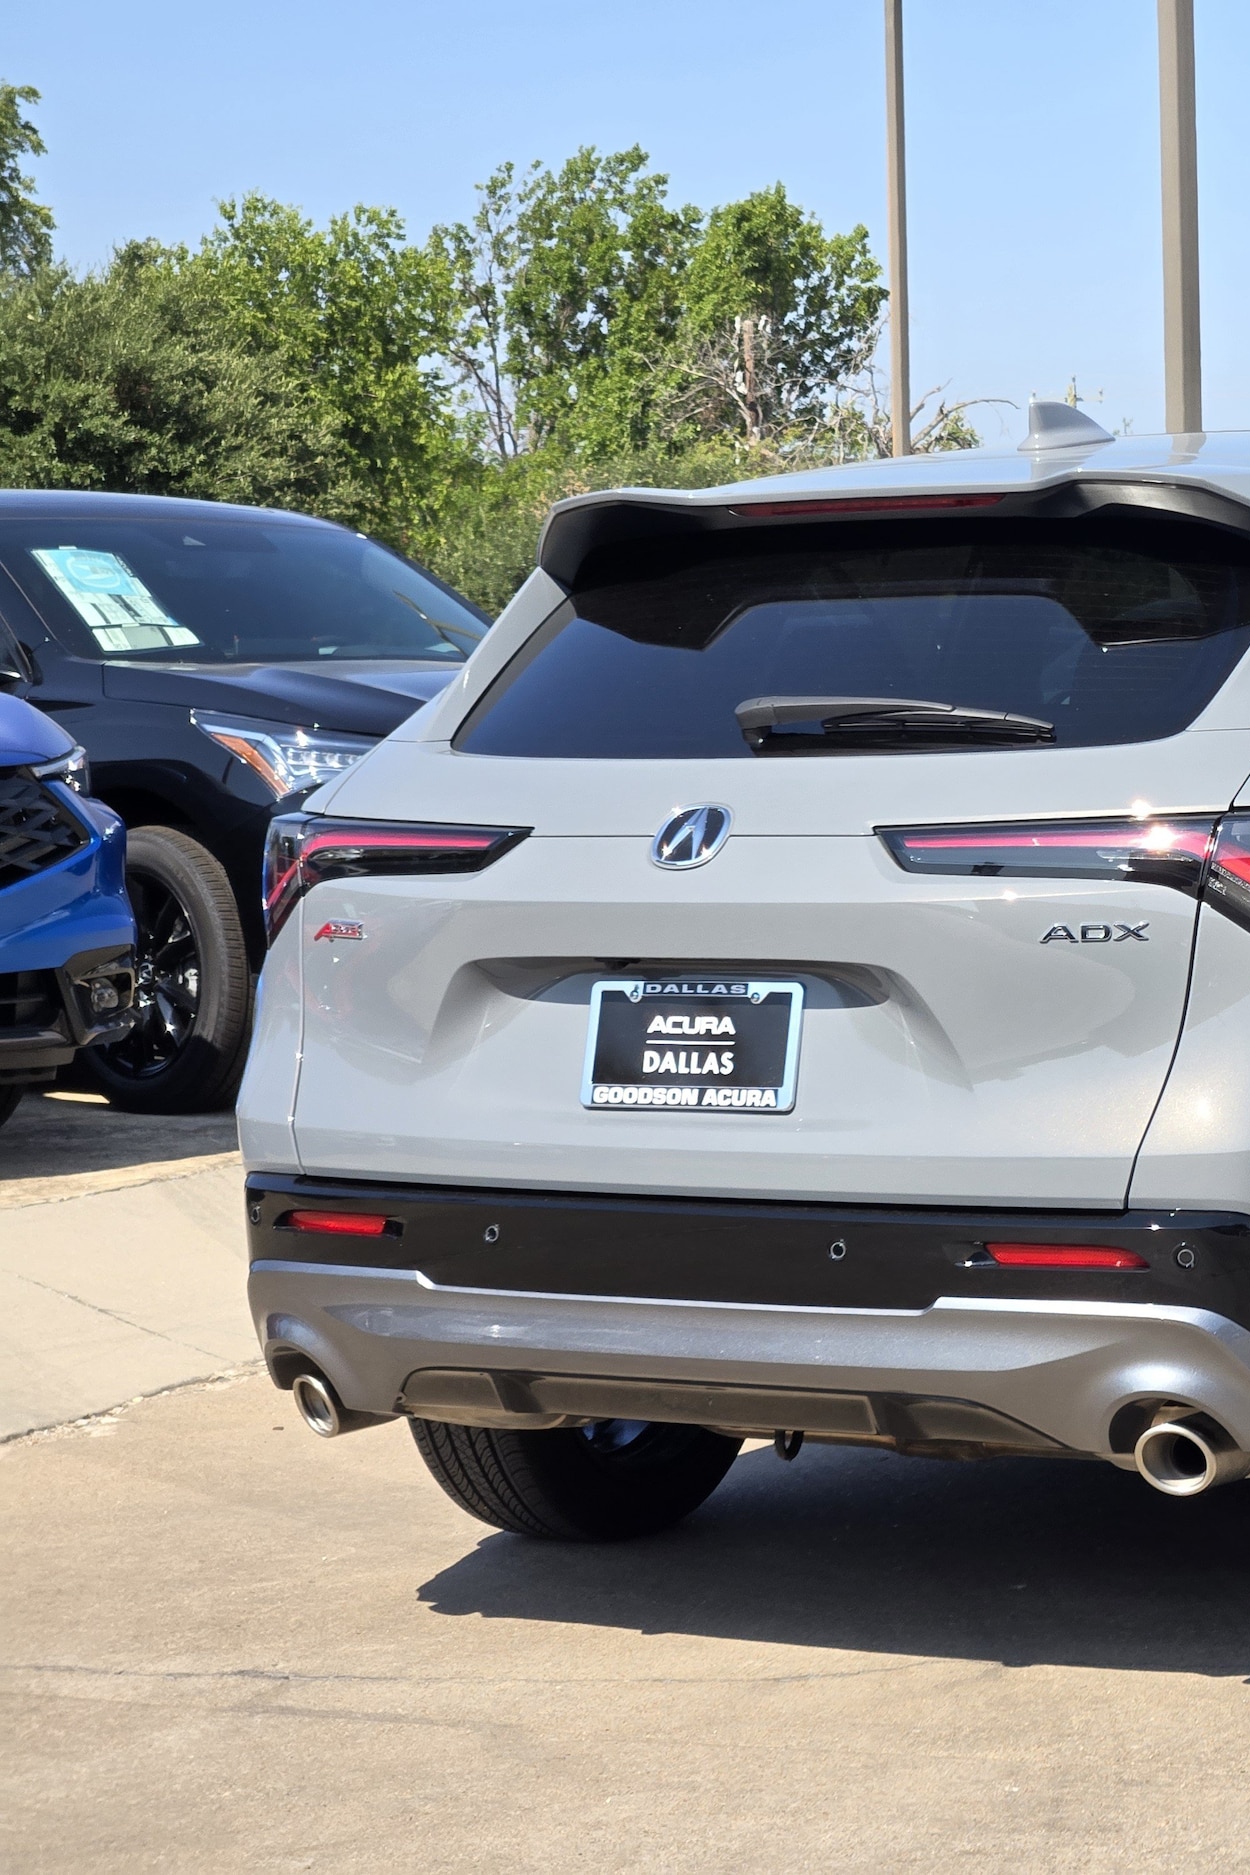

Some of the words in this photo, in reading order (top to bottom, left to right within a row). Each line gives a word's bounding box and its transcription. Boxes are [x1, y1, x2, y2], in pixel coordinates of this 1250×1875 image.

[1039, 921, 1150, 944] ADX
[646, 983, 747, 995] DALLAS
[647, 1015, 736, 1035] ACURA
[642, 1050, 735, 1076] DALLAS
[593, 1086, 698, 1107] GOODSON
[701, 1087, 778, 1108] ACURA
